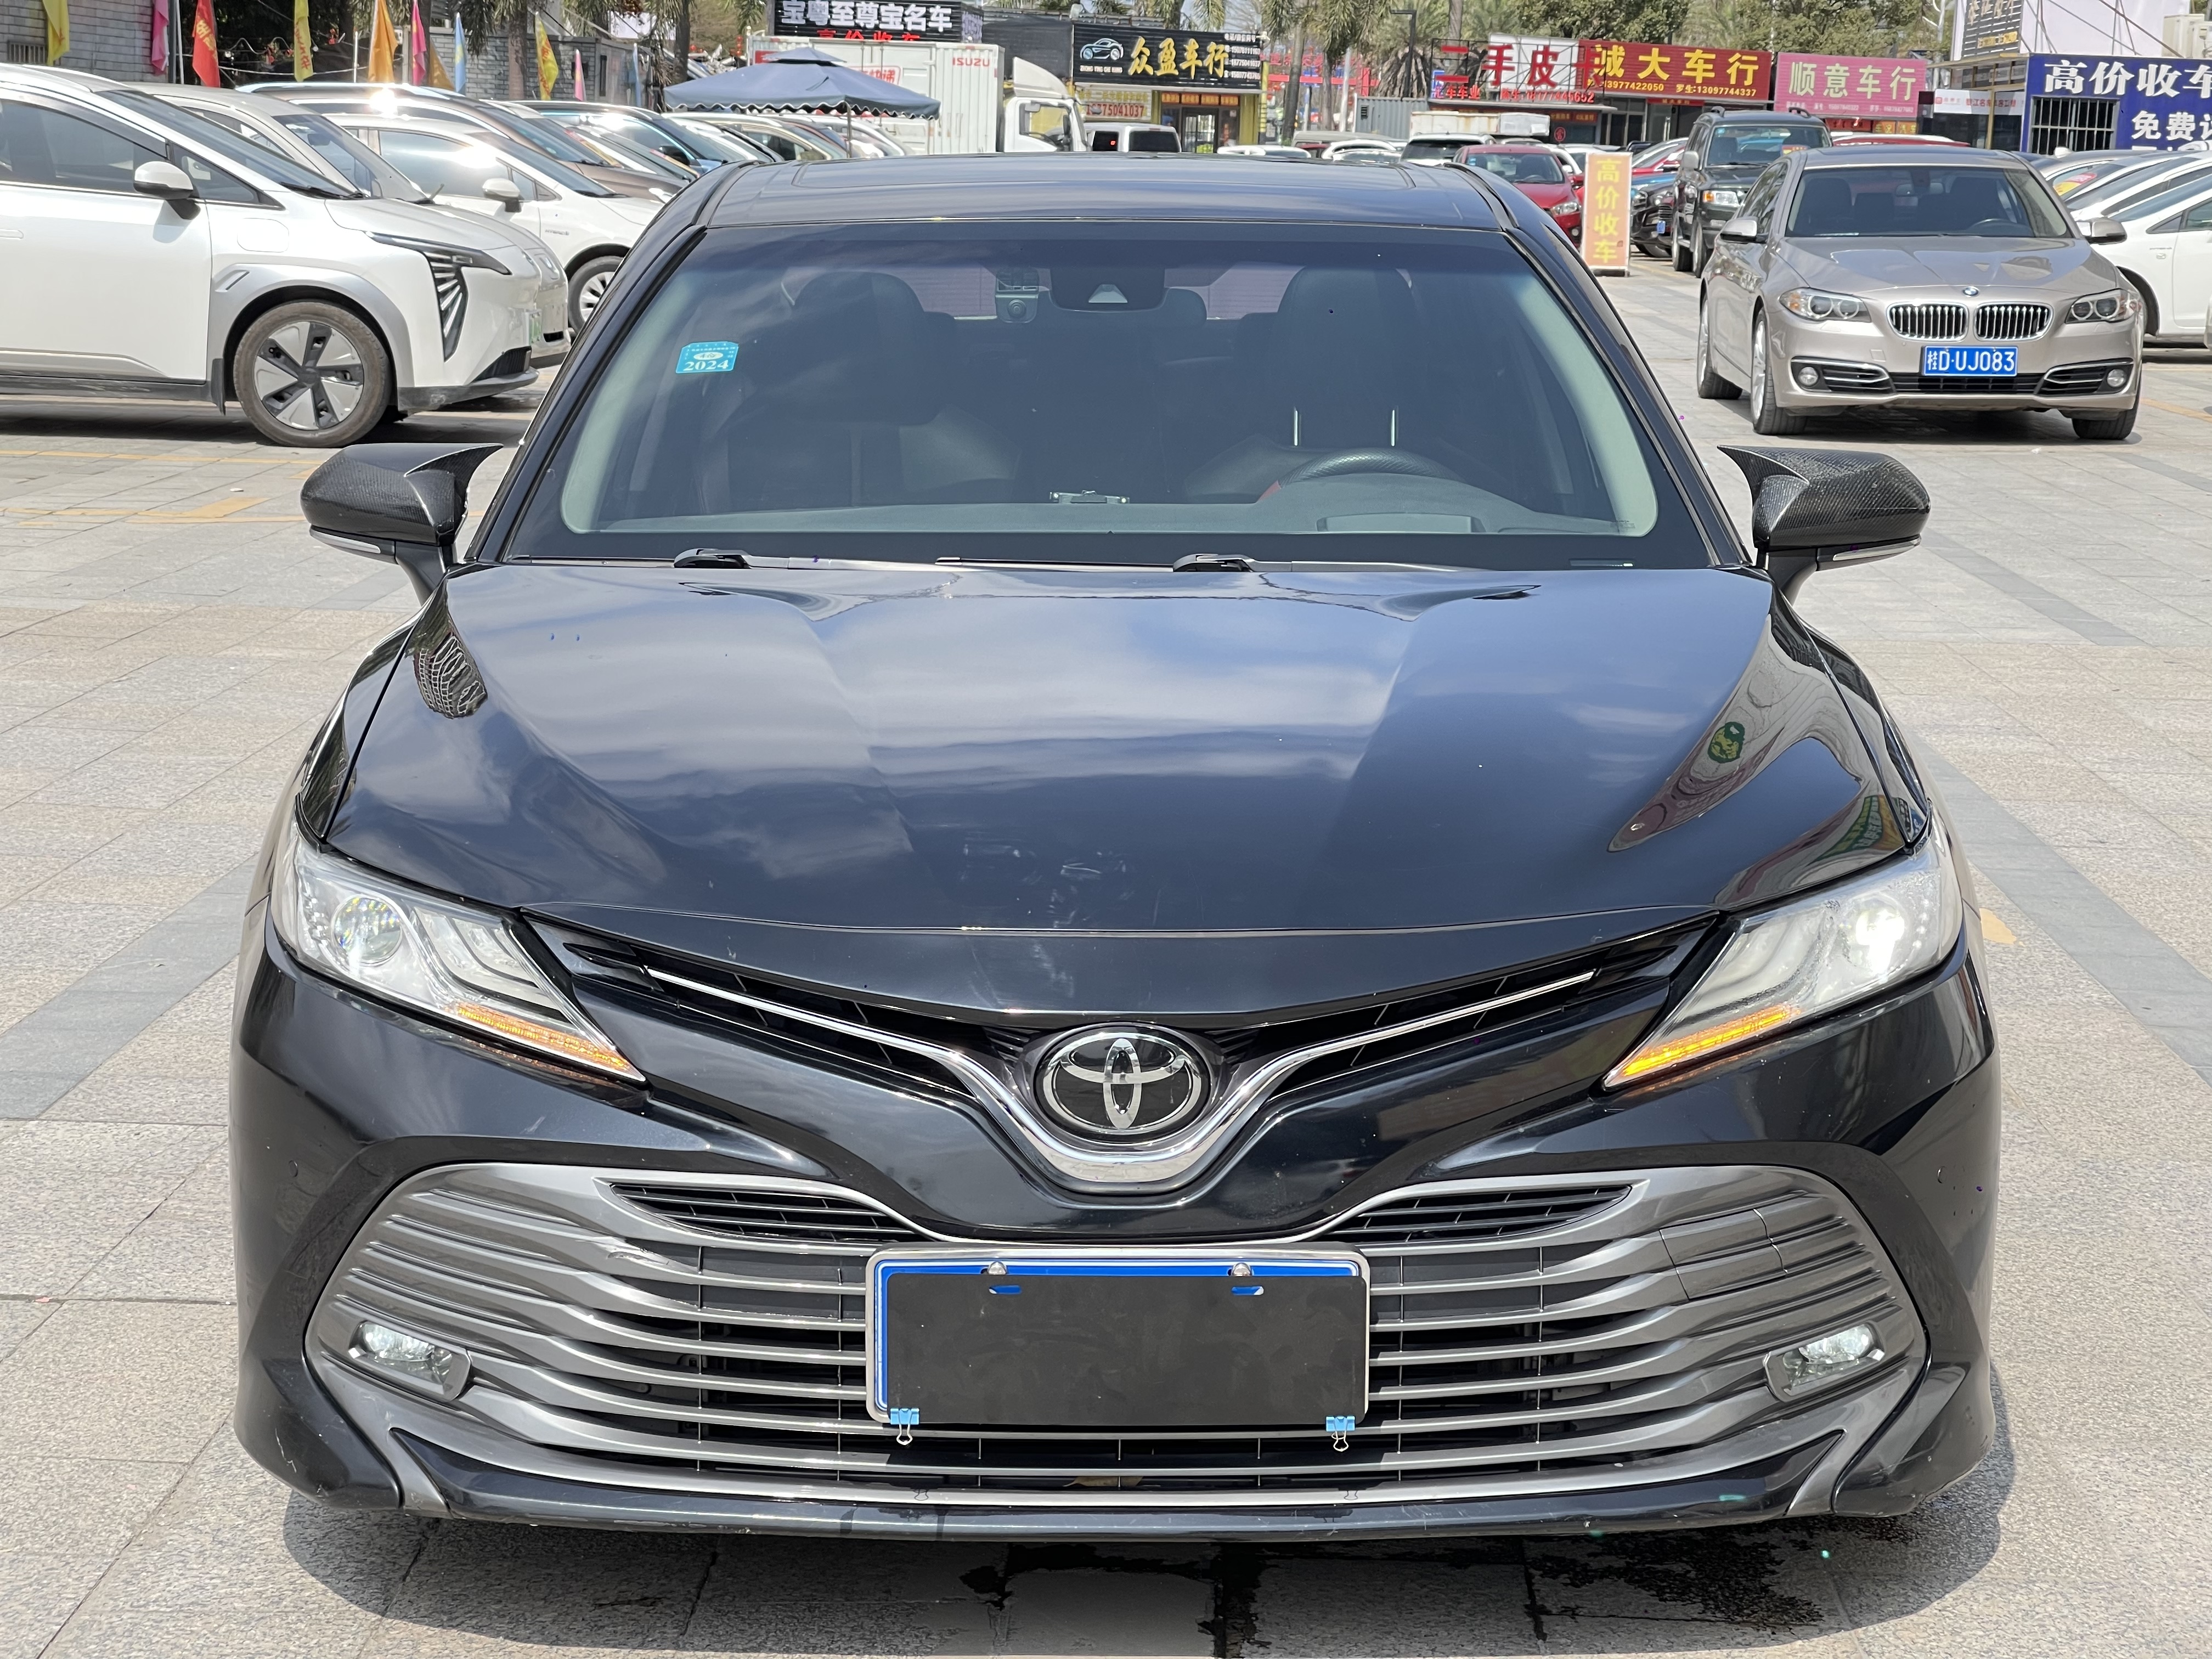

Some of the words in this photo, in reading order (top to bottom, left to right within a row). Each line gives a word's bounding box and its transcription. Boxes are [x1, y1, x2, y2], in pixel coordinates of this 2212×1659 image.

[952, 58, 990, 66] ISUZU
[1128, 36, 1228, 79] 众盈车行
[1435, 43, 1605, 89] 二手皮卡
[1594, 44, 1759, 86] 诚大车行
[1788, 61, 1916, 101] 顺意车行
[1593, 158, 1622, 263] 高价收车
[683, 360, 729, 371] 2024
